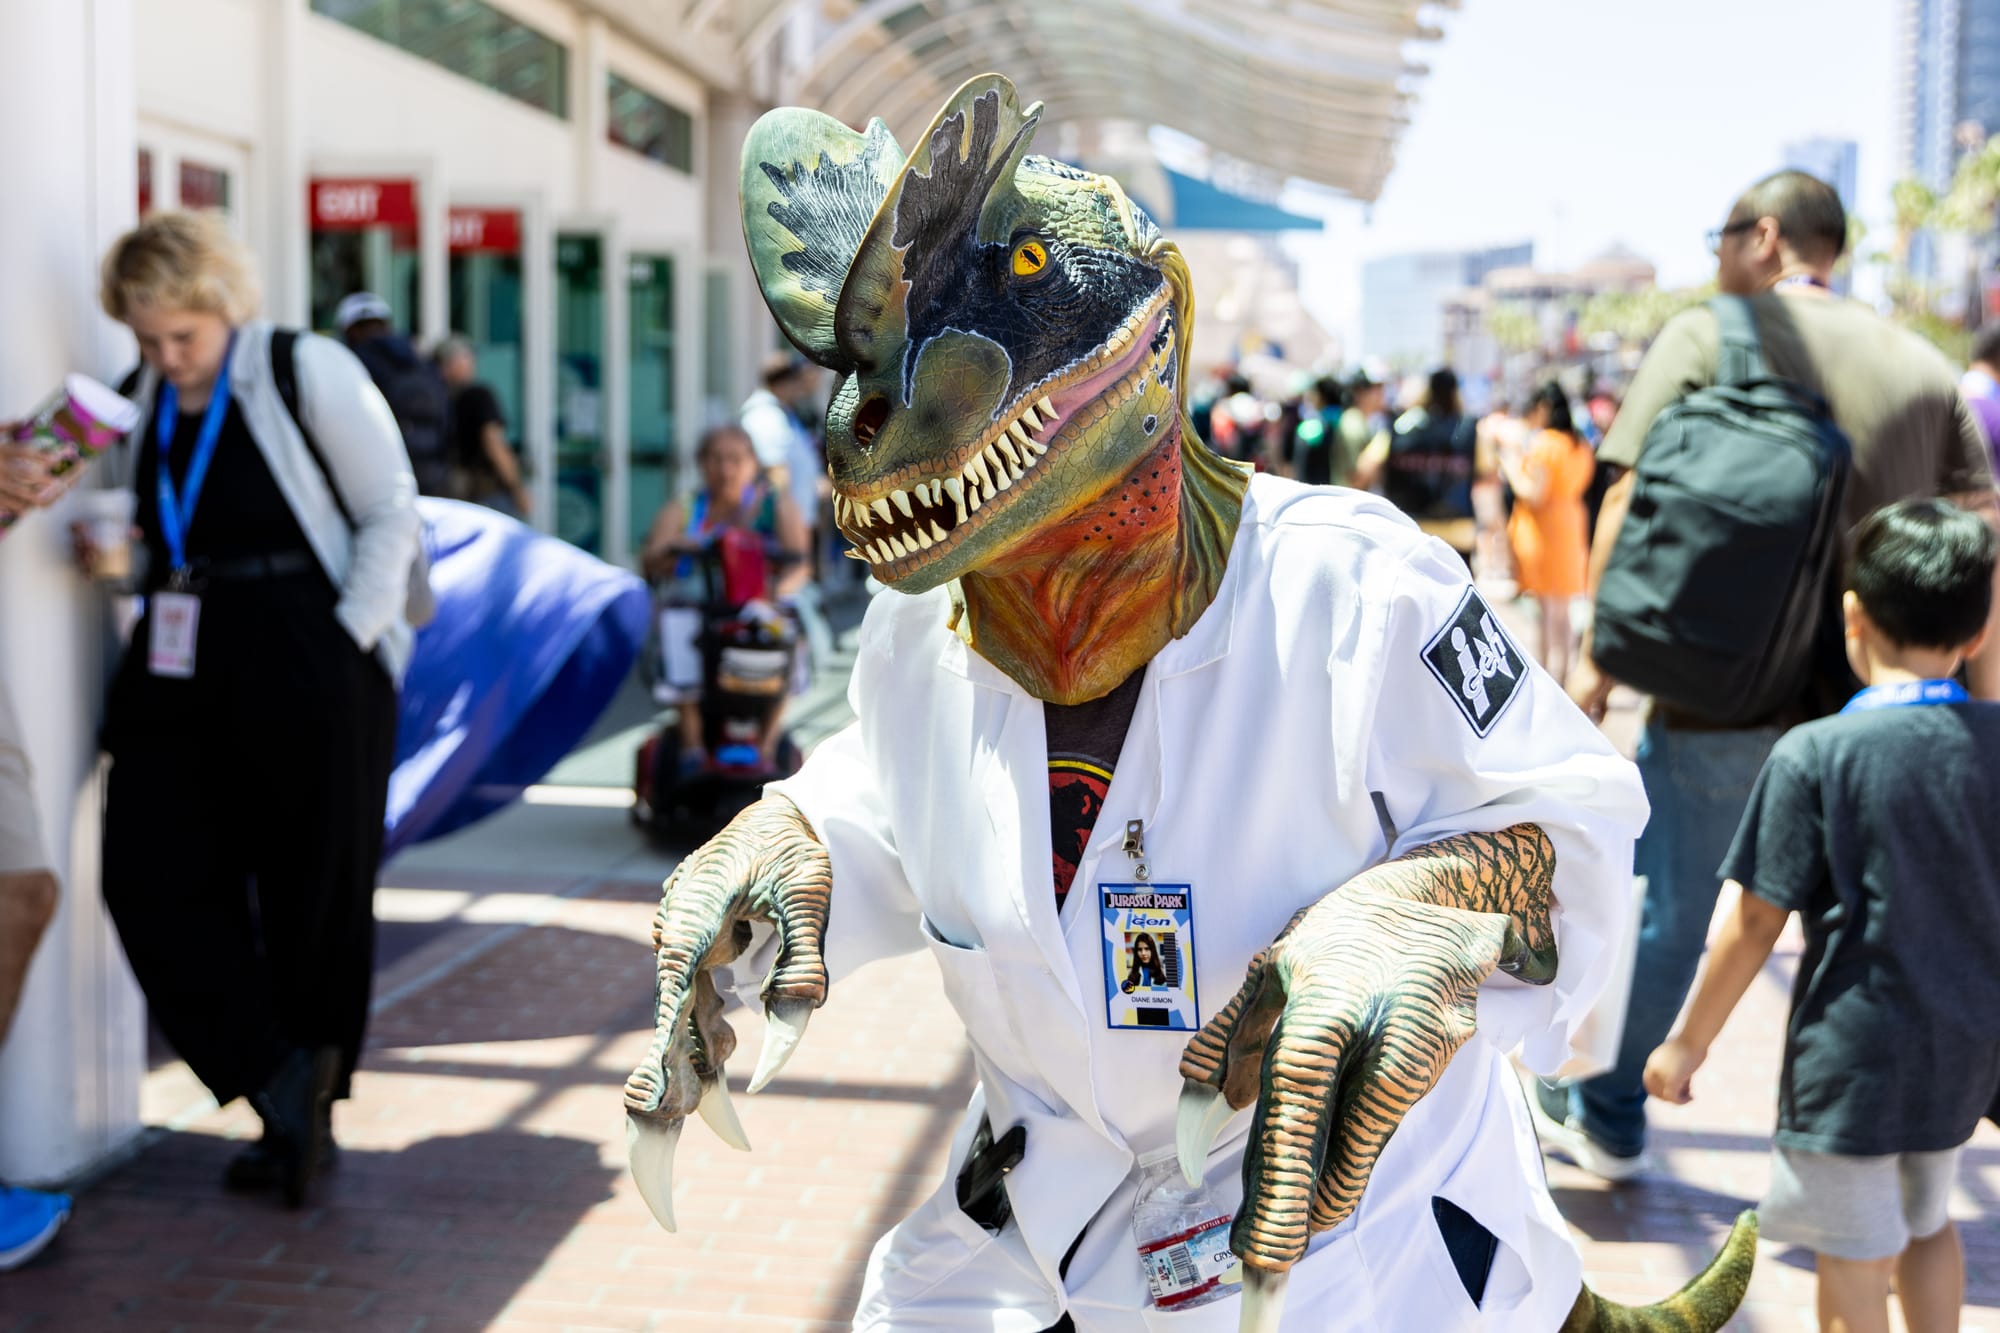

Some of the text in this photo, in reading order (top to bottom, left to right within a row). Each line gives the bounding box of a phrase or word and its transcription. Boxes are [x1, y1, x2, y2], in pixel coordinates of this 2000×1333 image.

[317, 186, 380, 221] EXIT
[447, 212, 485, 246] XIT
[1109, 894, 1183, 908] JURASSIC PARK
[1131, 996, 1150, 1004] DIANE
[1214, 1250, 1232, 1262] CRYS
